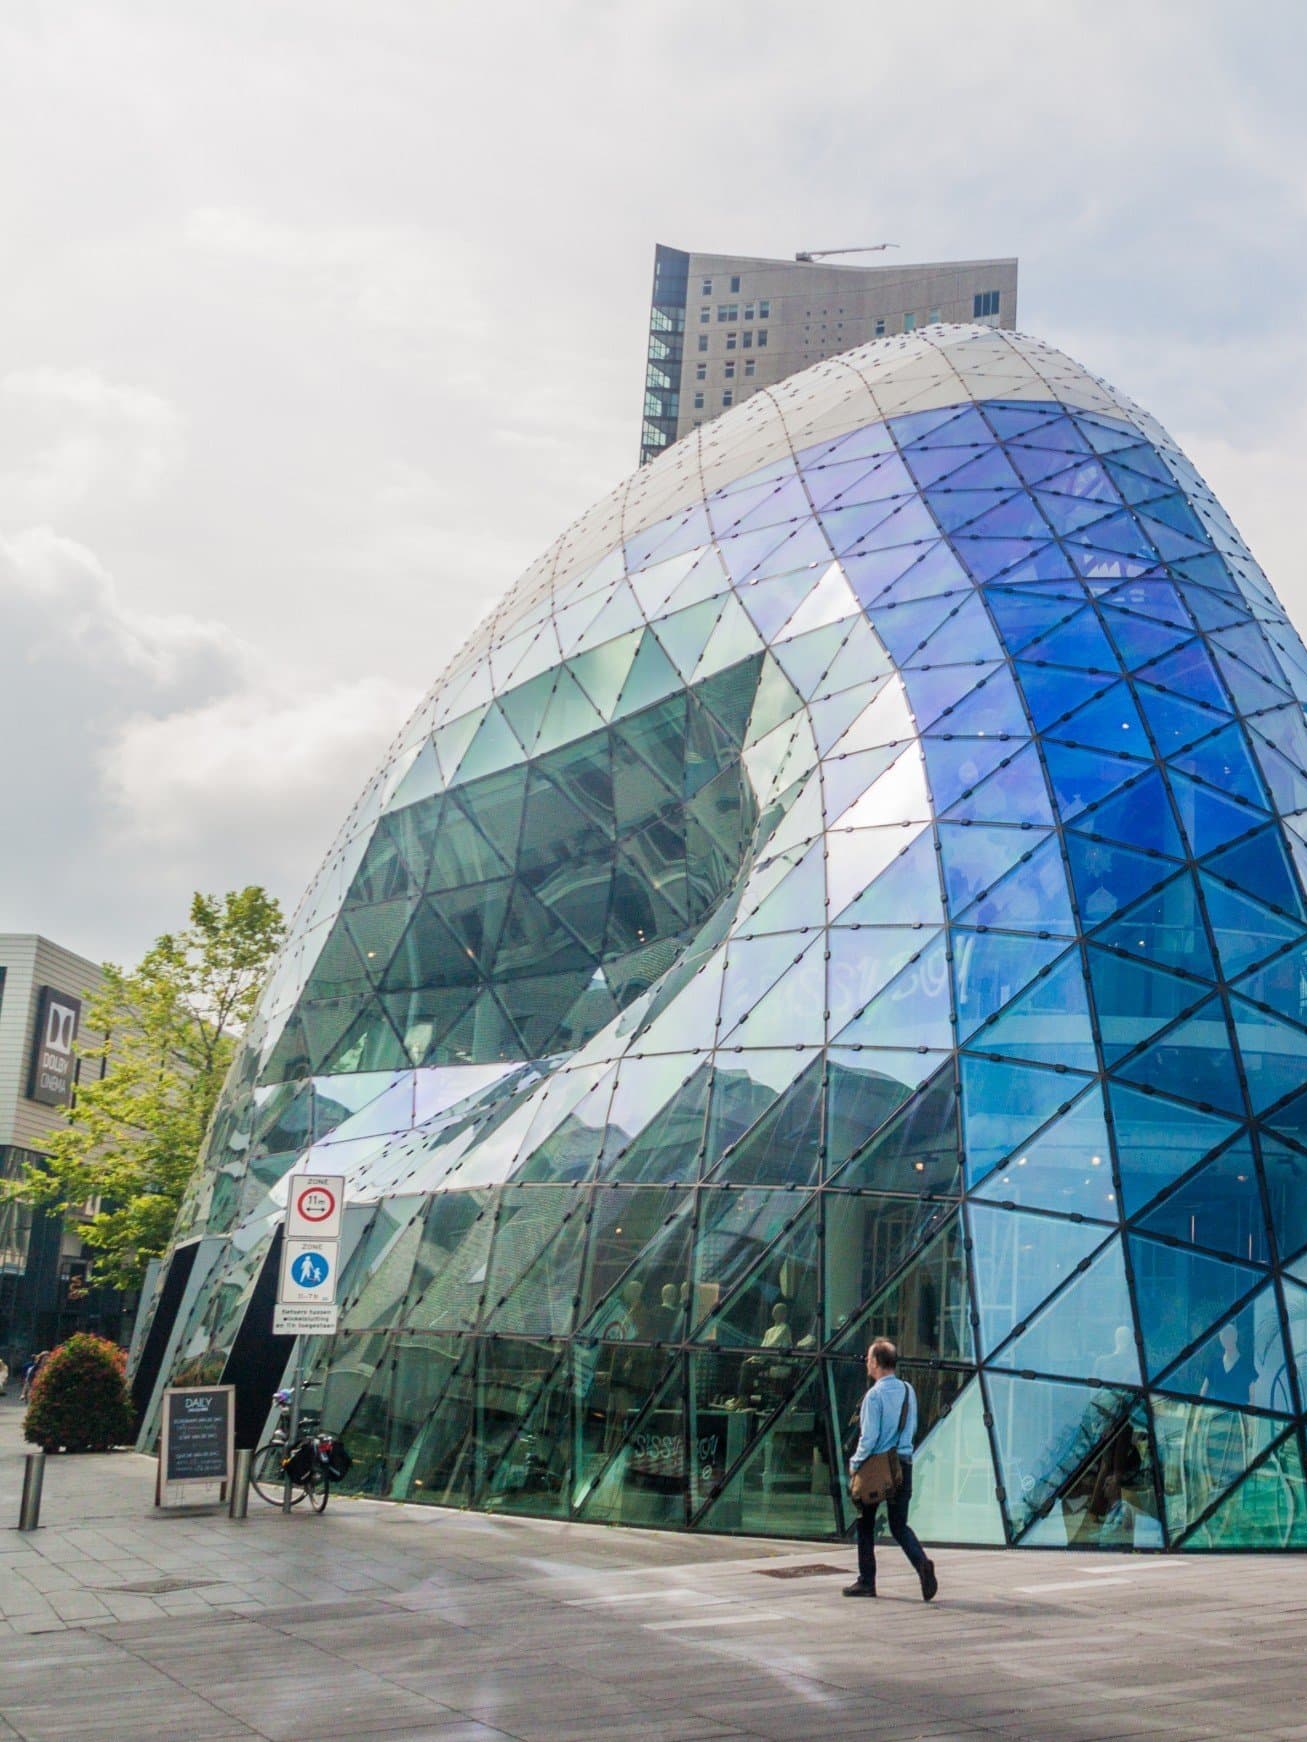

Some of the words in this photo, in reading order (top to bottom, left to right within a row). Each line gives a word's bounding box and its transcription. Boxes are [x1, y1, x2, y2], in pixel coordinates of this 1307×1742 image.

[43, 1053, 68, 1074] DOLBY
[40, 1073, 66, 1094] CINEMA
[184, 1398, 212, 1409] DAILY
